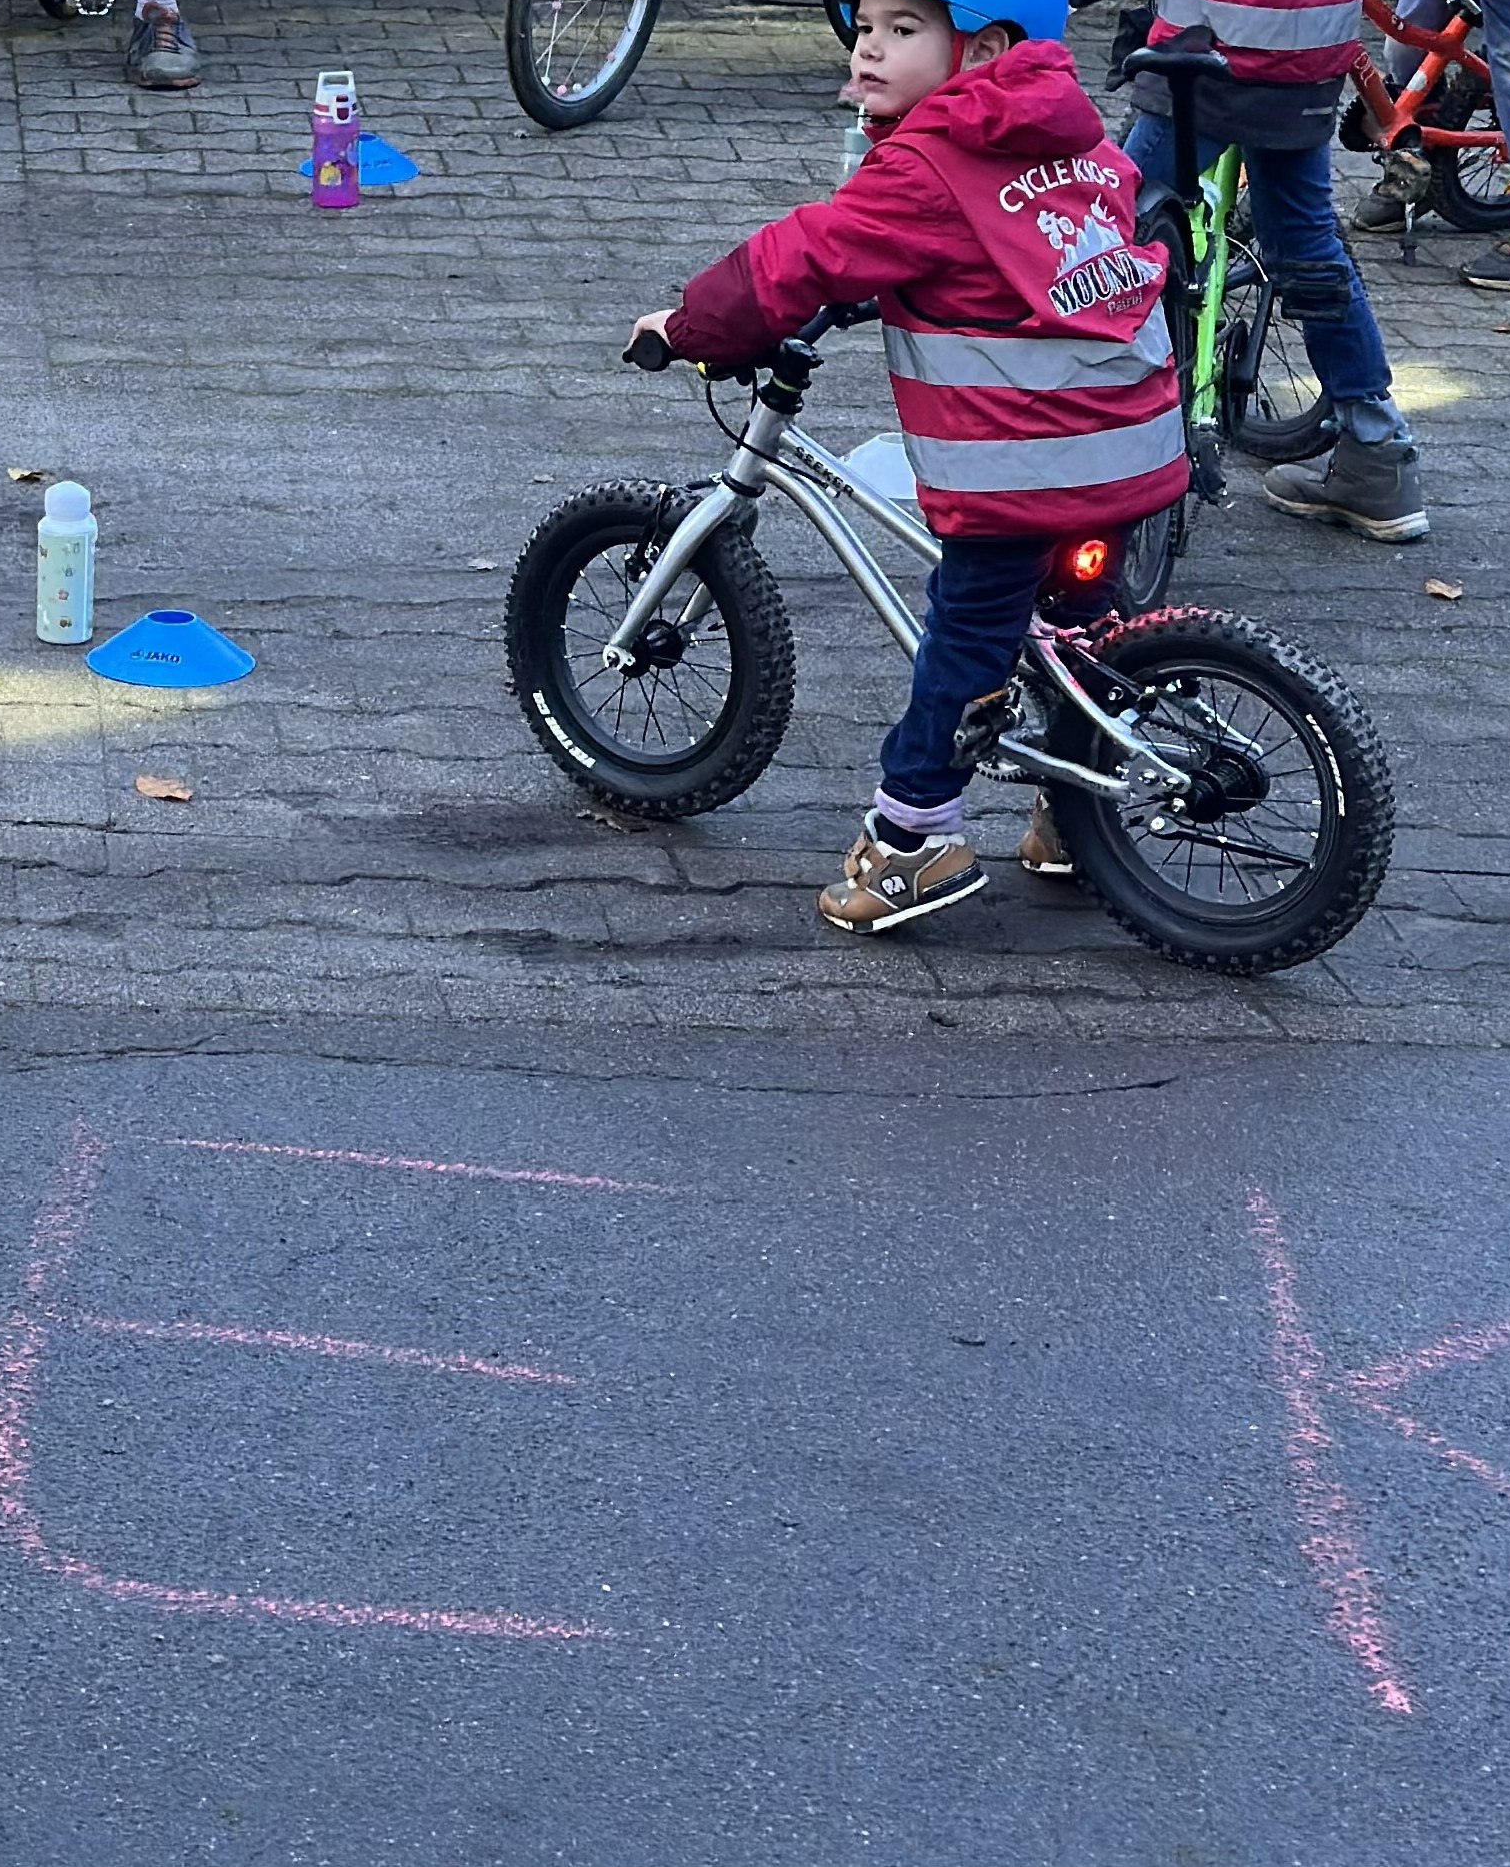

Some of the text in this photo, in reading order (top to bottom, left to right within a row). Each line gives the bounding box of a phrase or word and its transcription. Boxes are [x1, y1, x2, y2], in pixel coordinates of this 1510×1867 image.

[998, 157, 1120, 213] CYCLE KIDS
[1047, 248, 1152, 317] MOUNT
[795, 445, 855, 498] SEEKER
